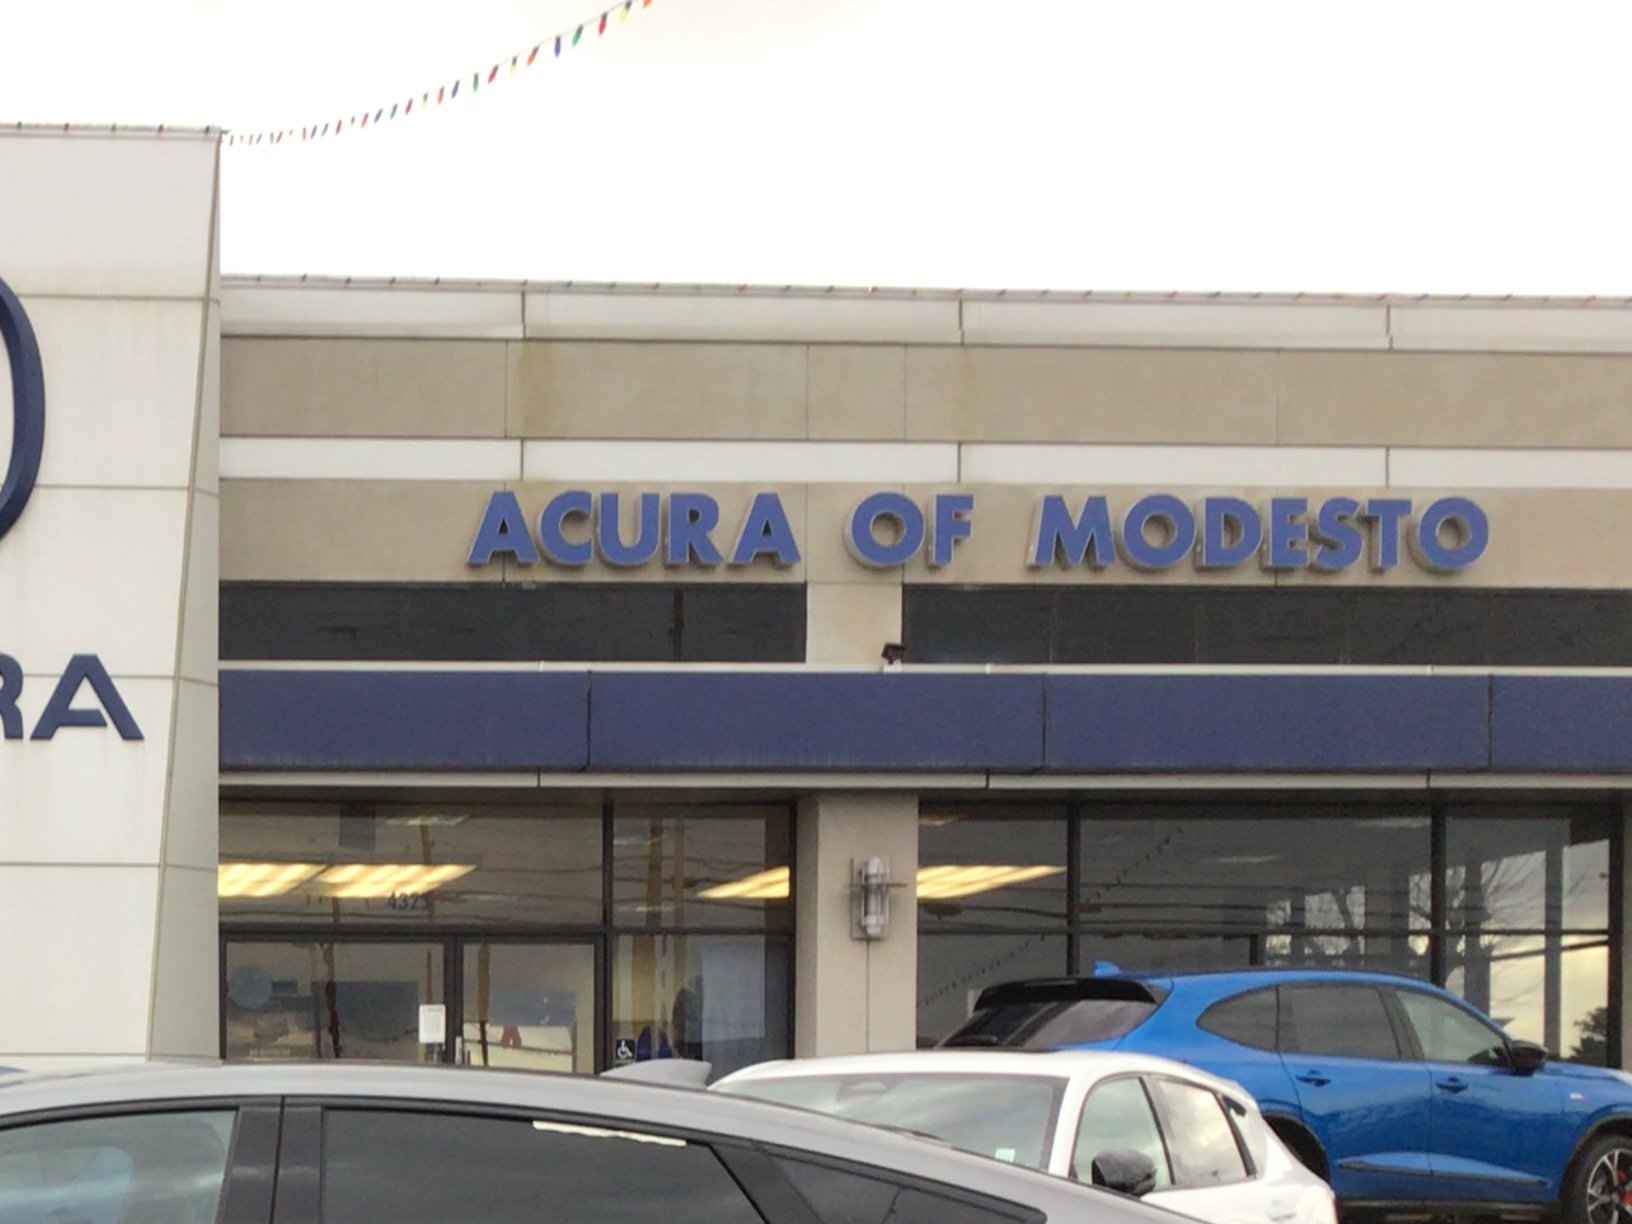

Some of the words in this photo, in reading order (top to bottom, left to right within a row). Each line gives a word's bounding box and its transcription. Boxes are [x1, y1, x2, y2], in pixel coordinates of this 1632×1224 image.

[466, 489, 802, 567] ACURA
[846, 490, 975, 569] OF
[1028, 493, 1490, 575] MODESTO
